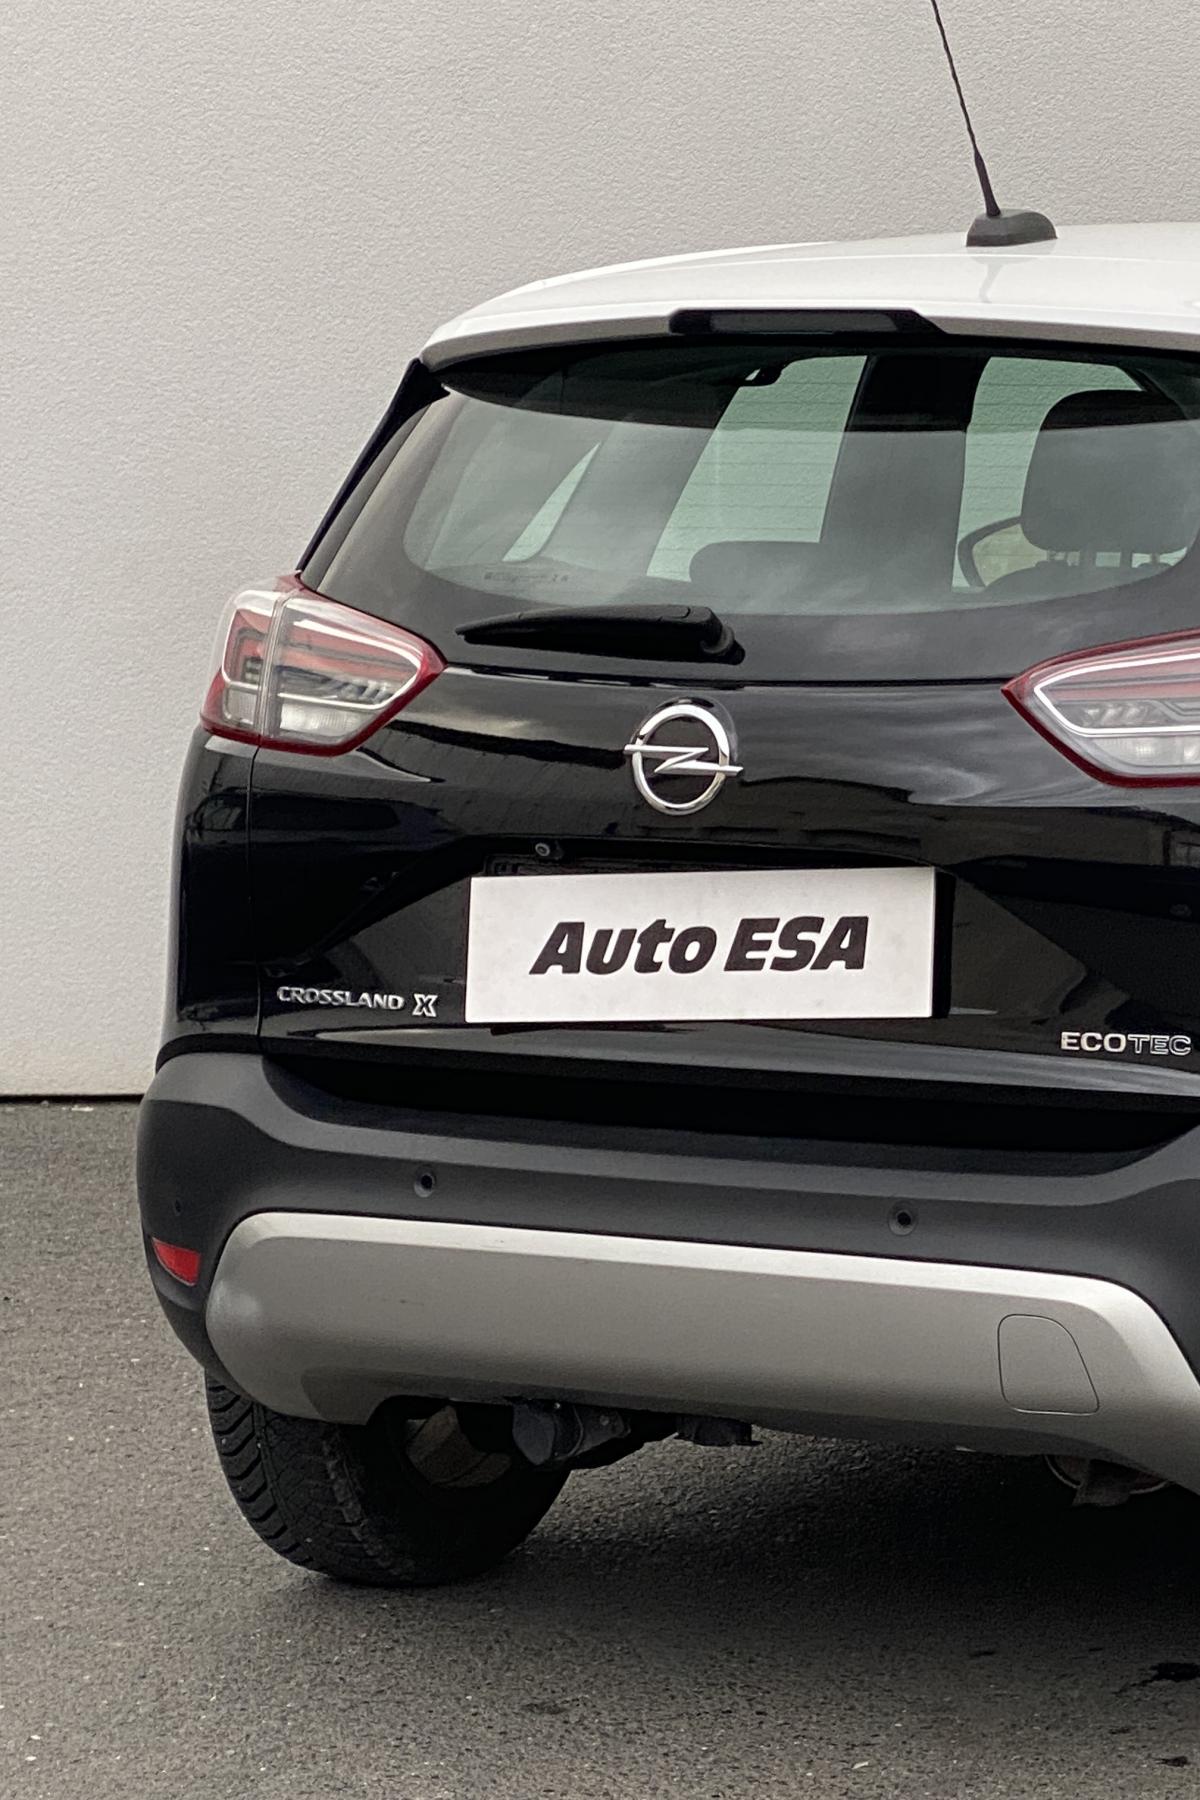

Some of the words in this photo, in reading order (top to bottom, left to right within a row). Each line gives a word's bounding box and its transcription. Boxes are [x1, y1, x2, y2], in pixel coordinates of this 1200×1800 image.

[529, 918, 717, 975] Auto
[723, 915, 869, 972] ESA
[276, 986, 405, 1010] CROSSLAND
[412, 993, 438, 1017] X
[1061, 1031, 1192, 1056] ECOTEC
